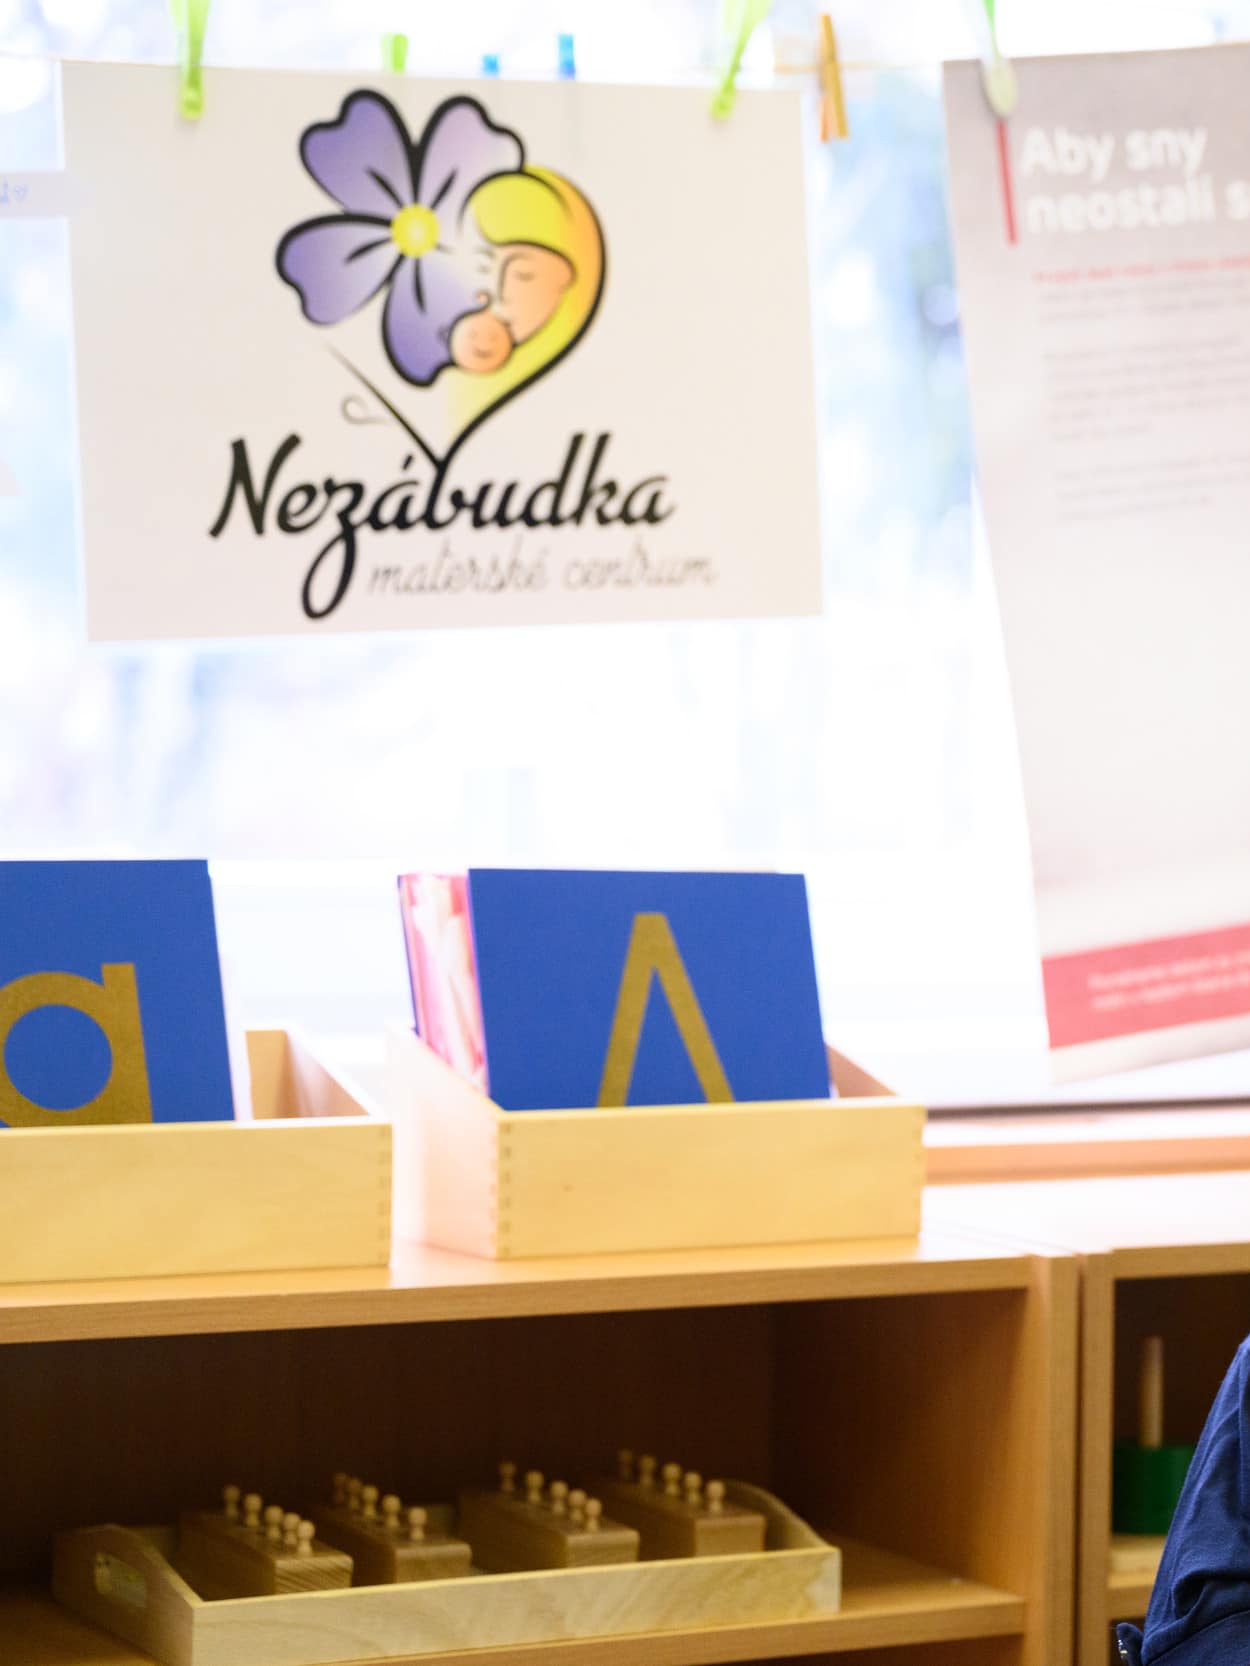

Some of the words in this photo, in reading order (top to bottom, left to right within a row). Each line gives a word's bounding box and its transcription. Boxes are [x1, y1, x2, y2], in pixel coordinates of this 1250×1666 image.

[1021, 127, 1115, 181] Aby
[1125, 127, 1207, 174] sny
[1027, 174, 1215, 232] neostali
[209, 432, 674, 618] Nezábudka
[563, 533, 717, 592] centrum
